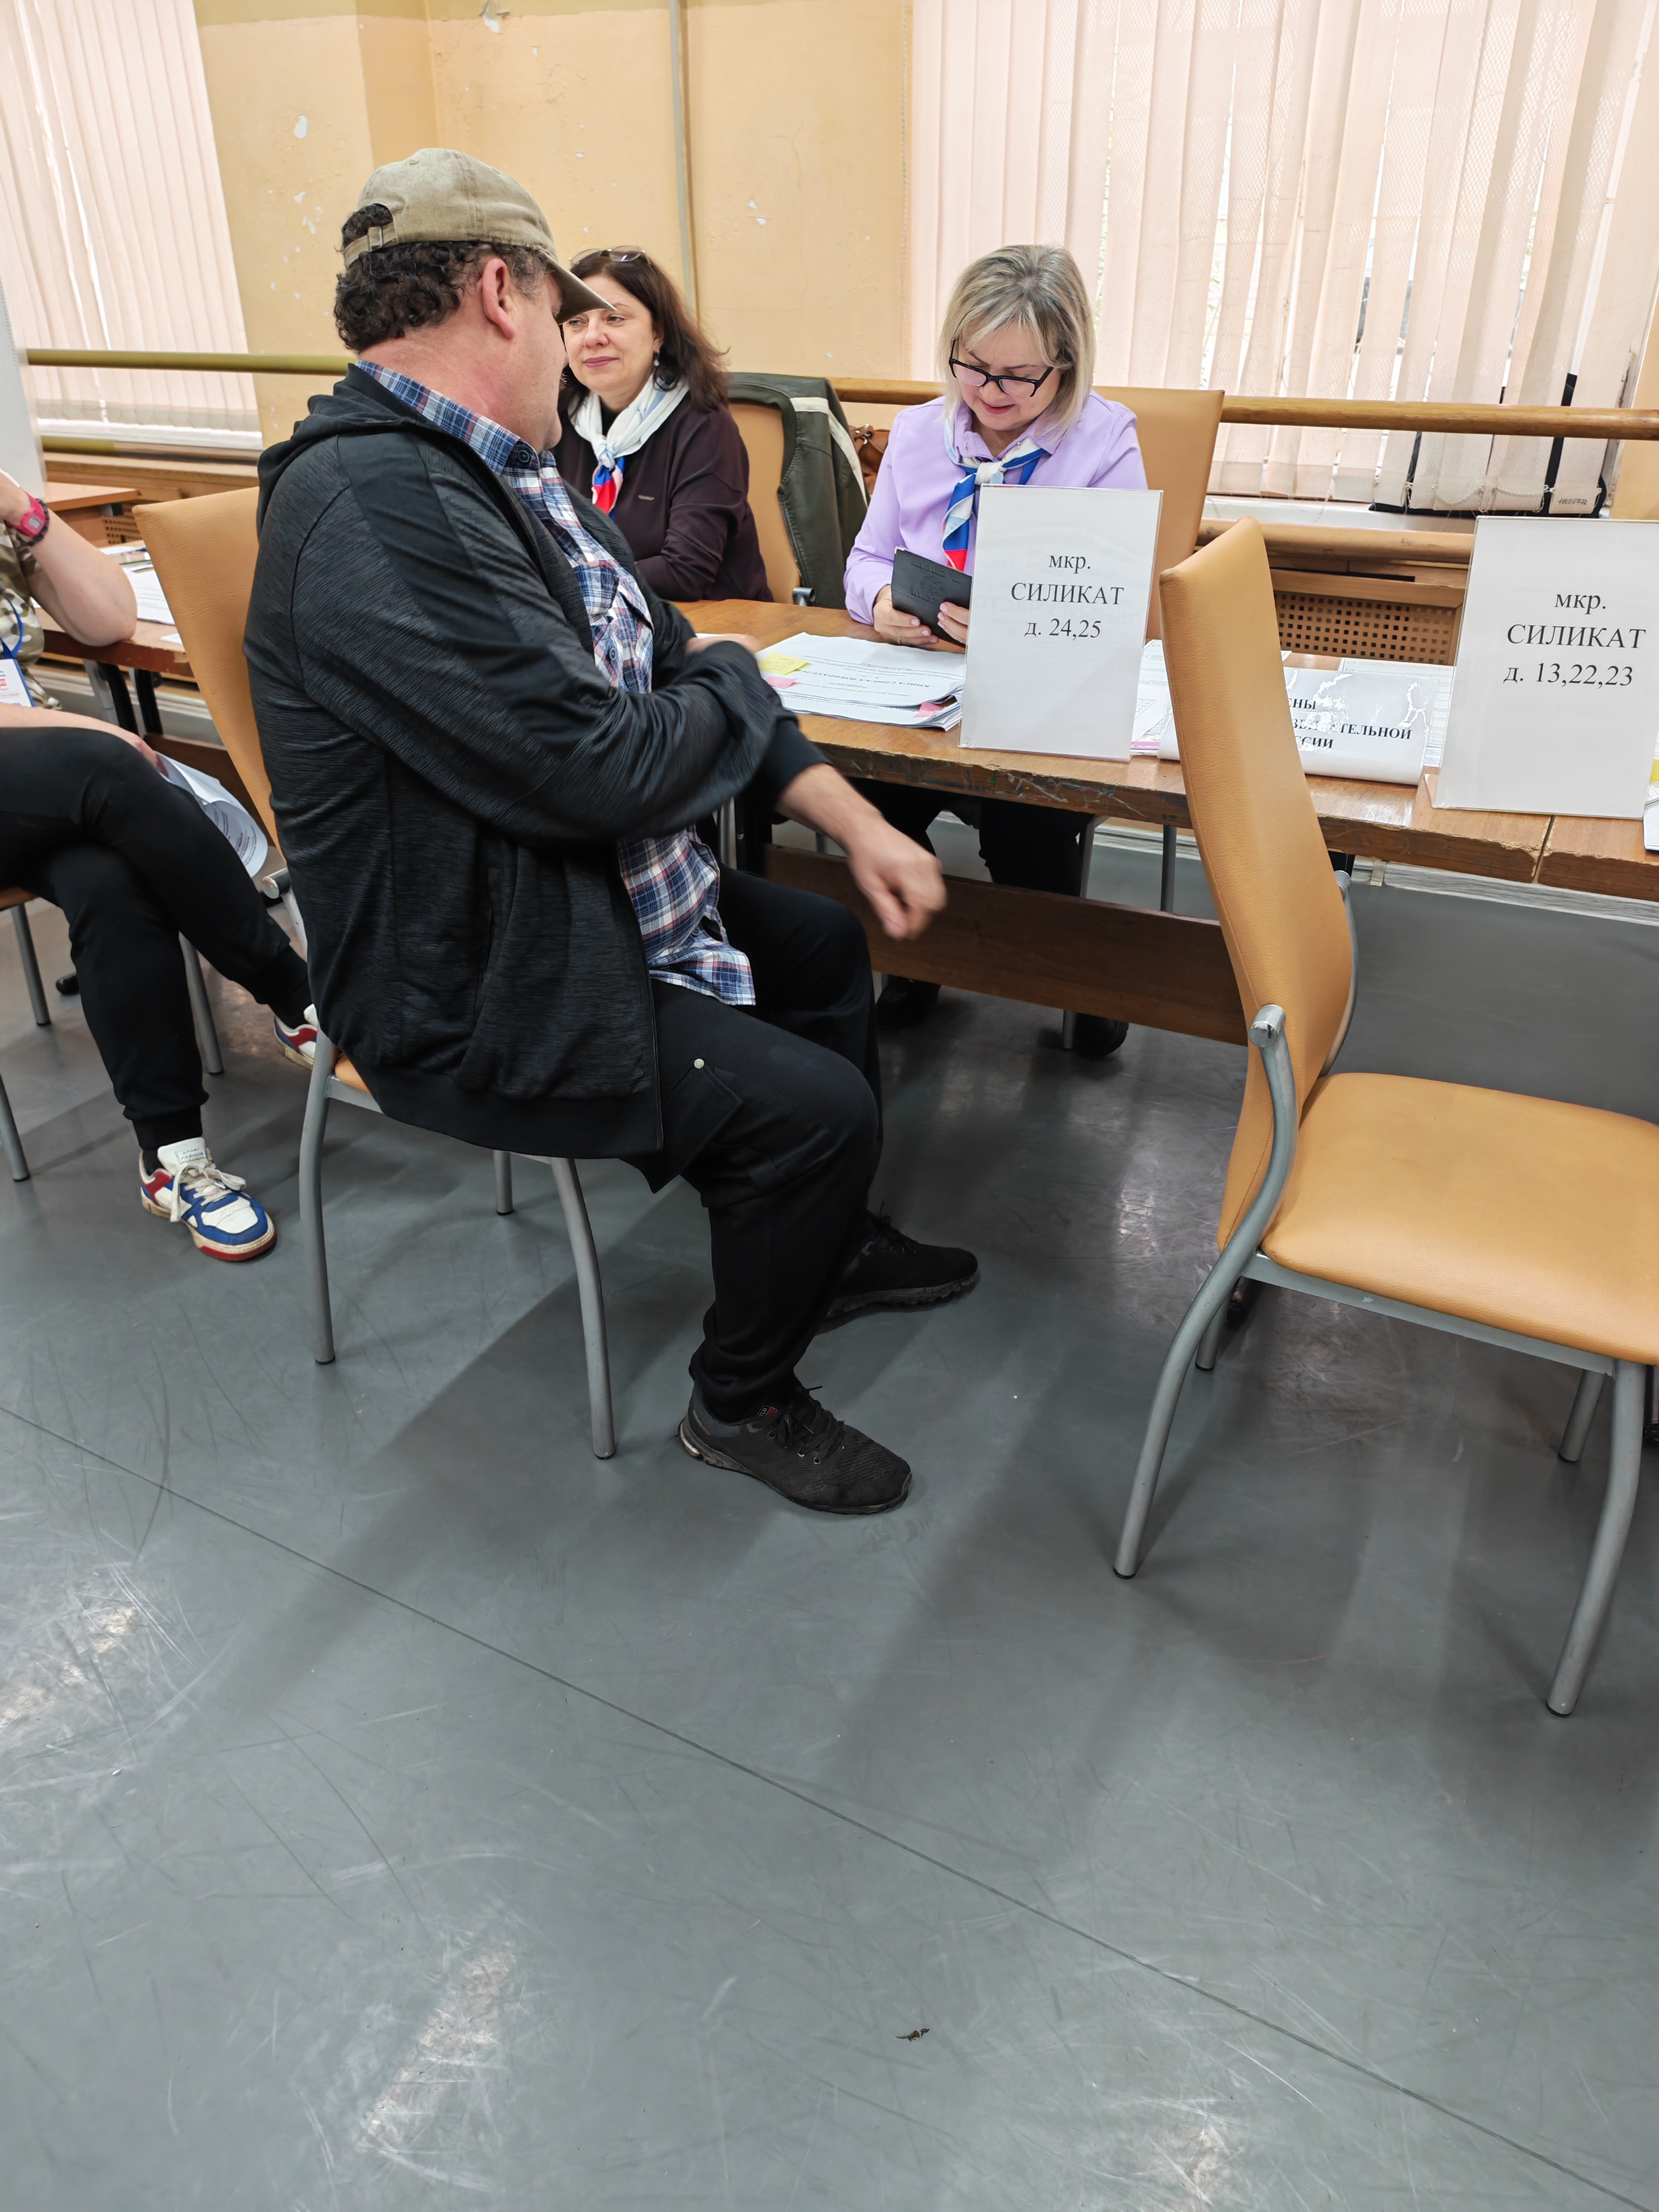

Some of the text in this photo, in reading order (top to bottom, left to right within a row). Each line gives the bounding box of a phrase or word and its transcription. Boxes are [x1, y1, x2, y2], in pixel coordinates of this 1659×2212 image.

[1048, 555, 1091, 574] мкр.
[1011, 583, 1124, 605] СИЛИКАТ
[1554, 594, 1606, 615] мкр.
[1024, 618, 1102, 640] д. 24,25
[1507, 624, 1646, 649] СИЛИКАТ
[1503, 663, 1633, 689] д. 13,22,23
